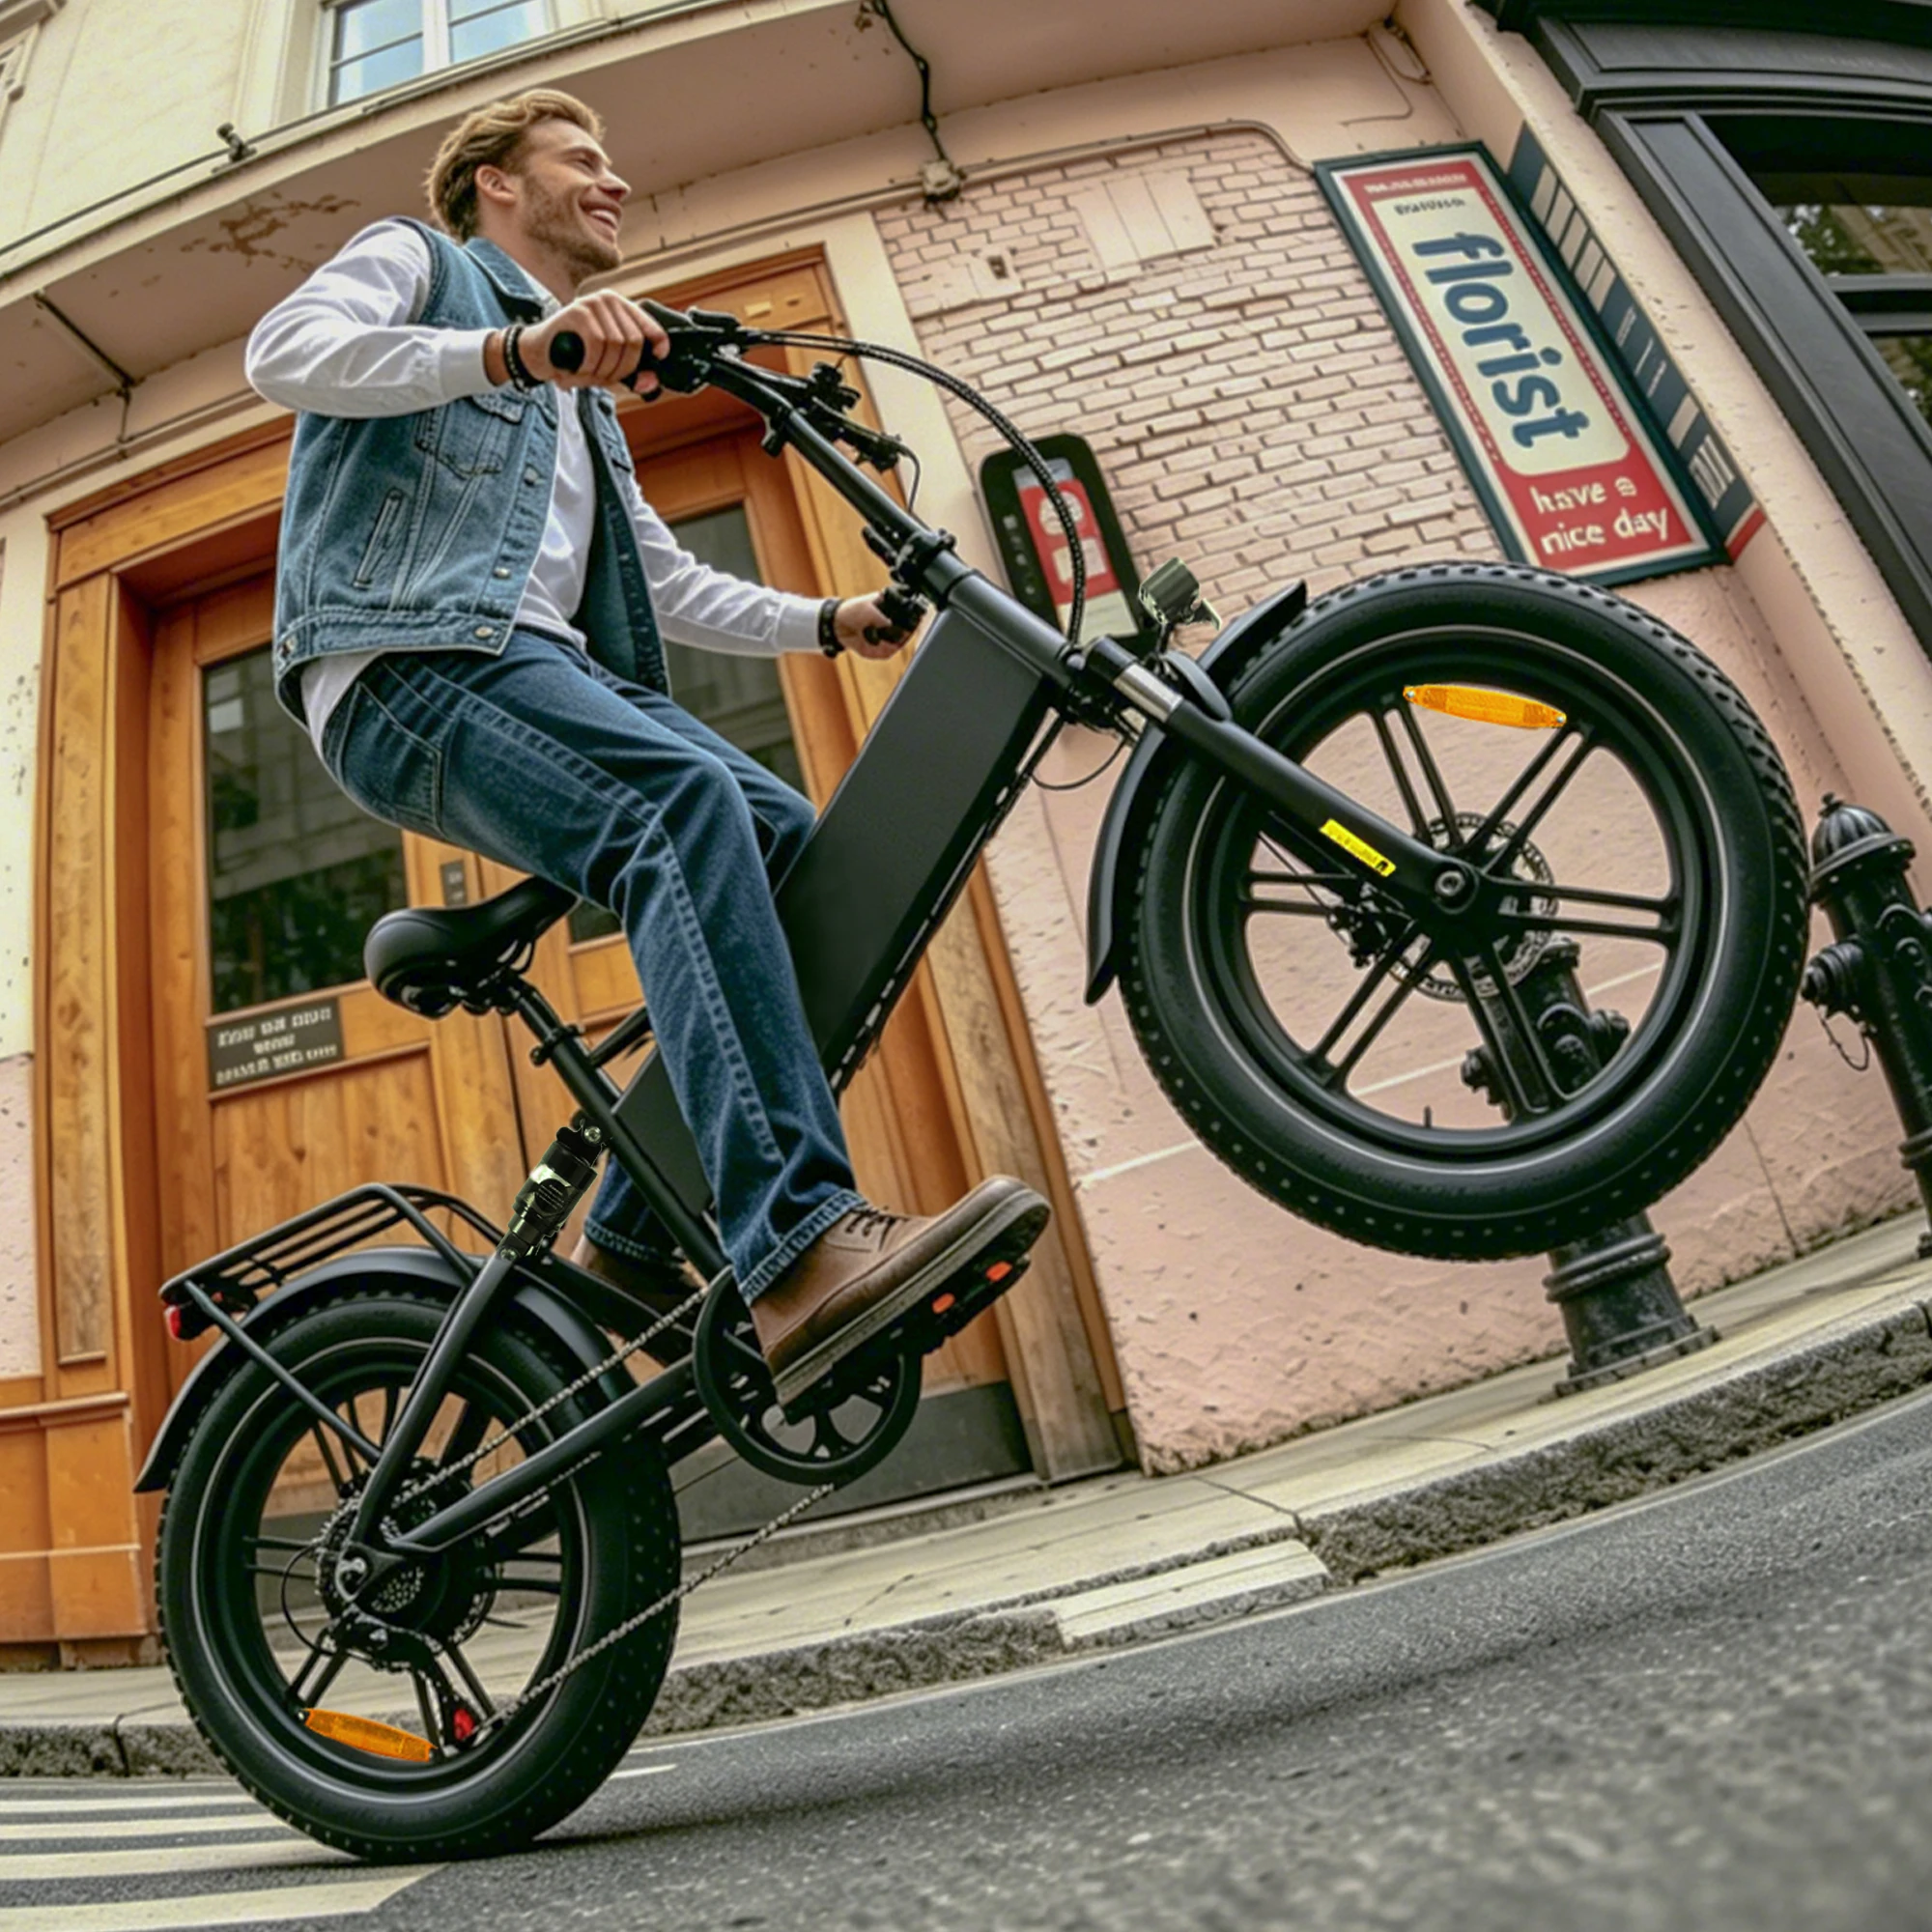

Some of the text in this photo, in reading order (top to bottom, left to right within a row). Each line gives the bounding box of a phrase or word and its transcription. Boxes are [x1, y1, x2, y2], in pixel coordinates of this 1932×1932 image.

[1412, 233, 1589, 447] florist
[1529, 483, 1606, 513] have
[1541, 508, 1667, 554] nice day
